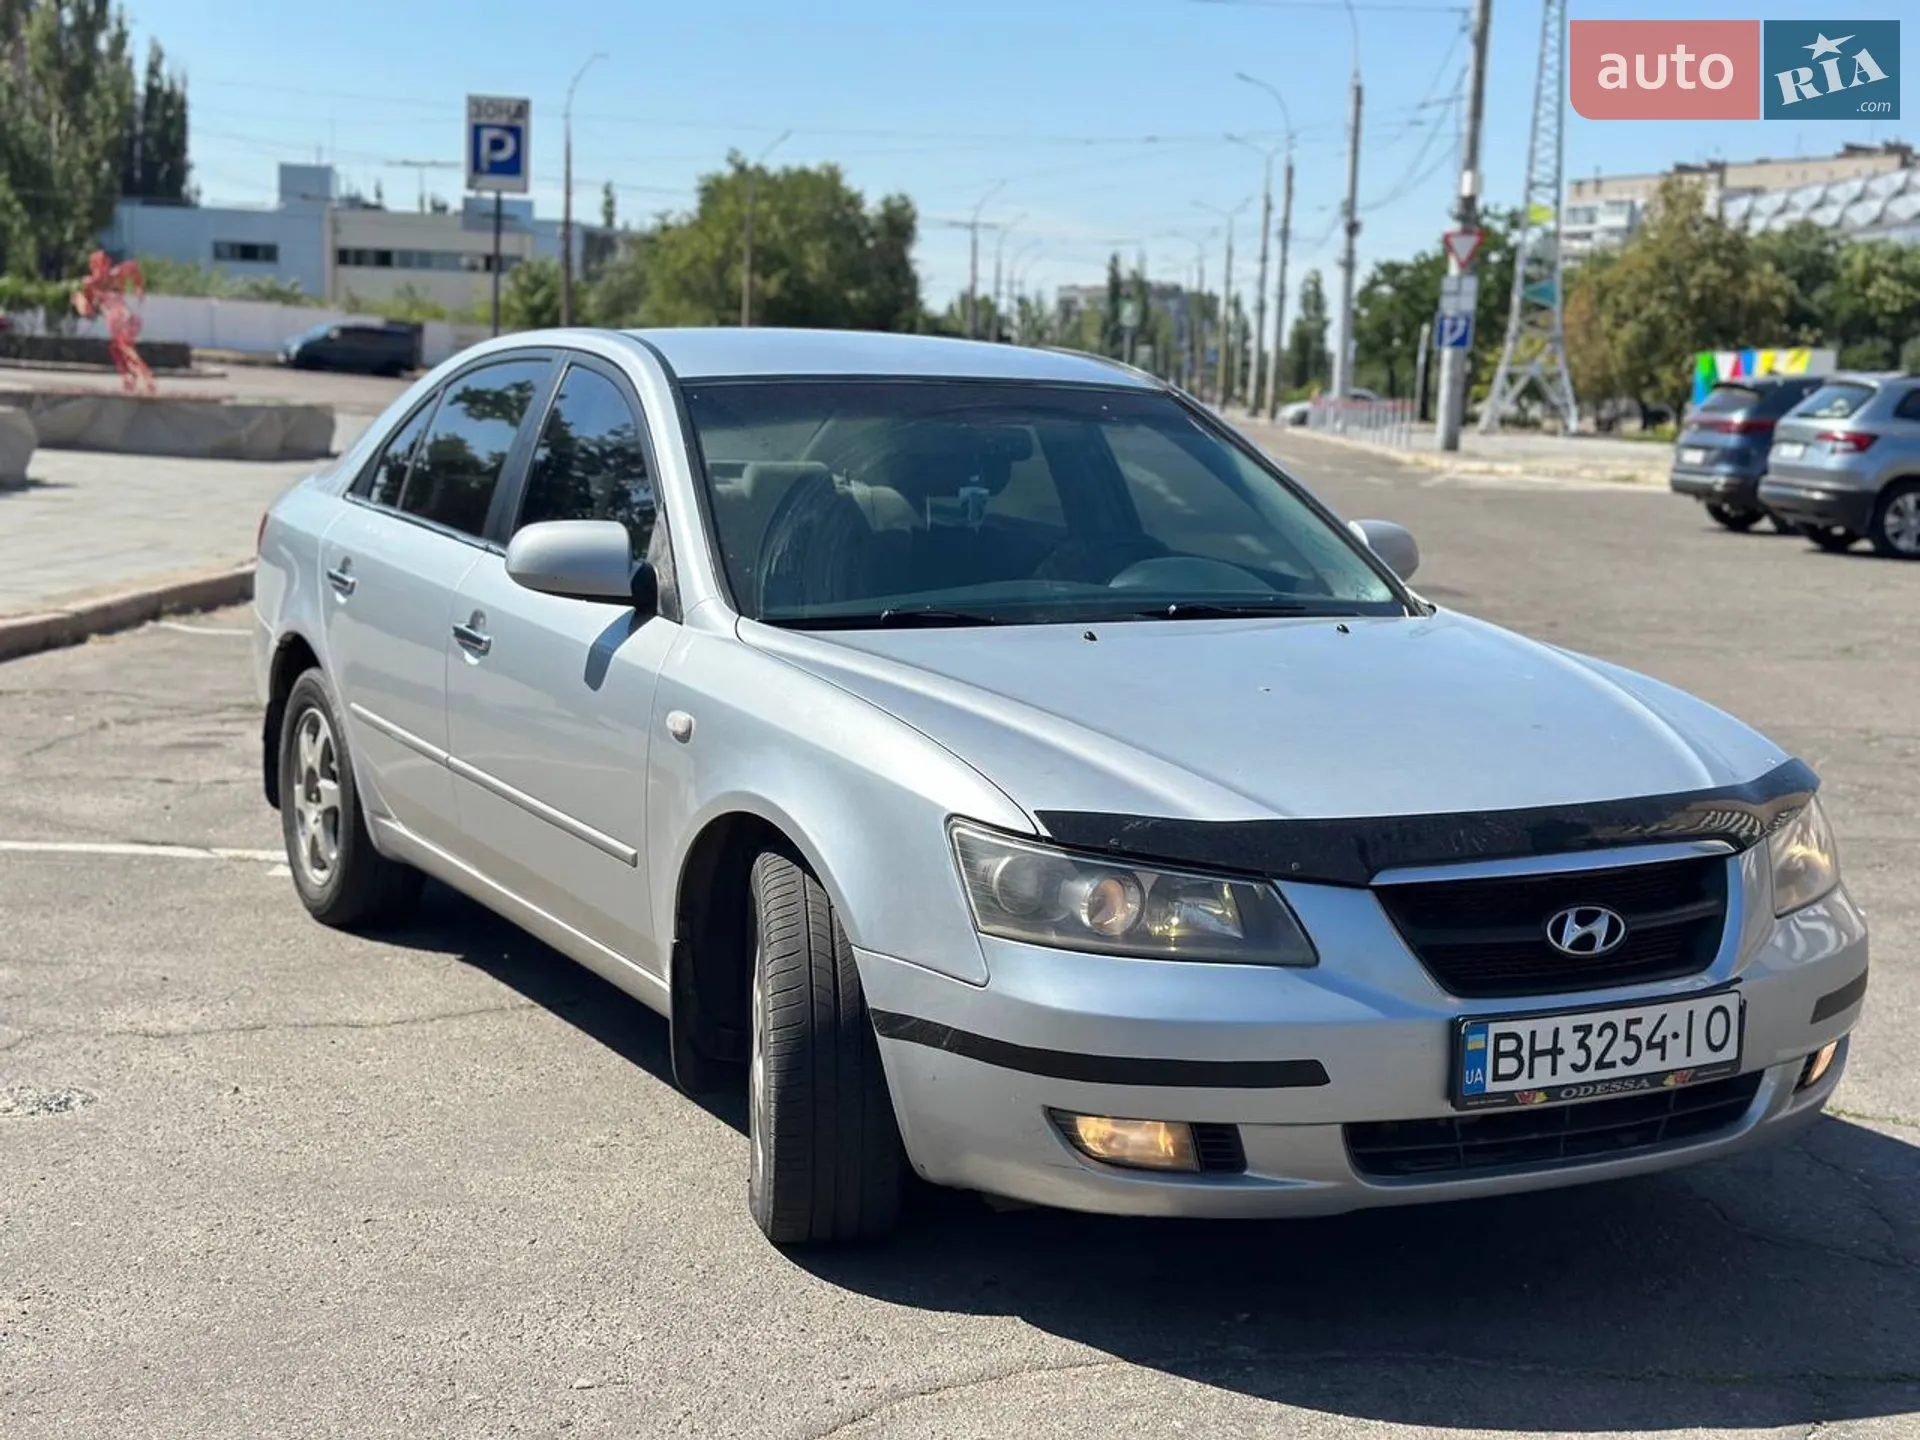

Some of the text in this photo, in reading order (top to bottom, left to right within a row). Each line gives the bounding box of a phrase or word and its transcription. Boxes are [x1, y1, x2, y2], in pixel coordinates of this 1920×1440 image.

[481, 127, 516, 172] P
[1465, 1067, 1484, 1084] UA
[1560, 1078, 1650, 1099] ODESSA
